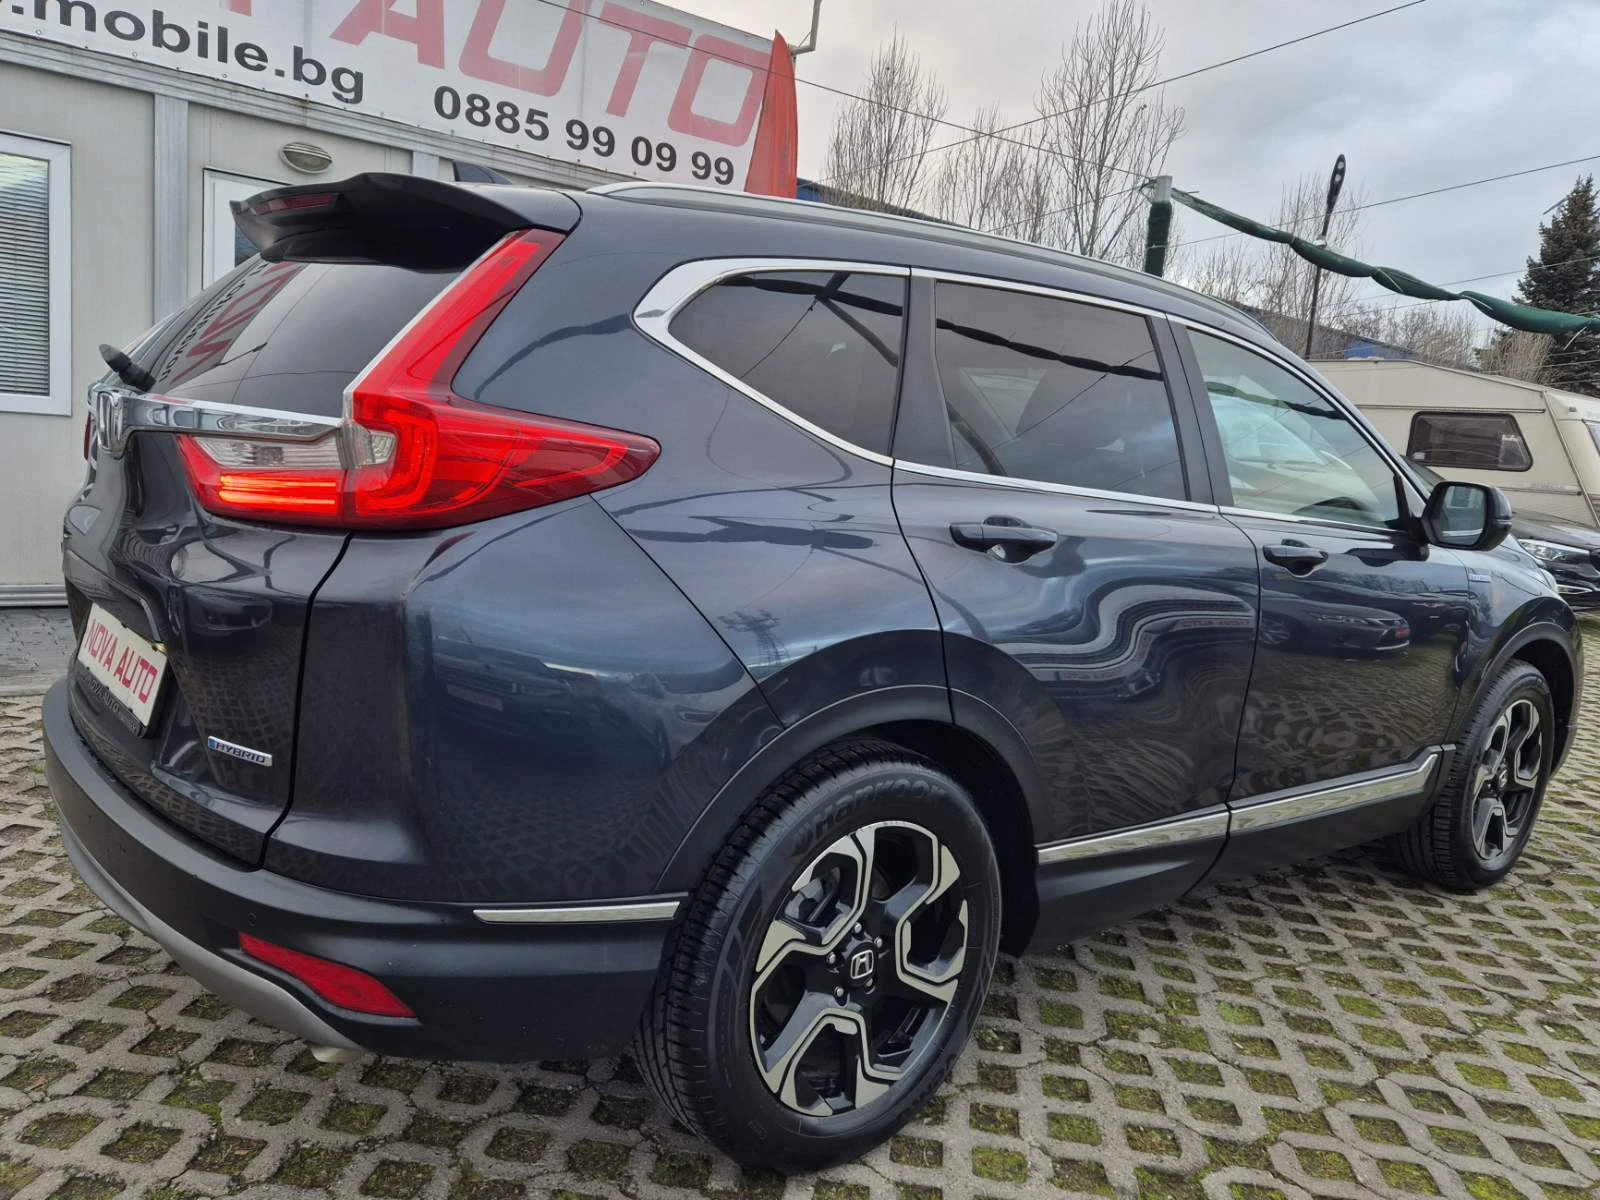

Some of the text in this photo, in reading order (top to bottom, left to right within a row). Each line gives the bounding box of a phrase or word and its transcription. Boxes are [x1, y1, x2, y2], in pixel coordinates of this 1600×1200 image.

[0, 0, 364, 104] .mobile.bg
[433, 85, 735, 186] 0885 99 09 99
[84, 618, 158, 704] NOVA AUTO
[216, 742, 266, 763] HYBRID
